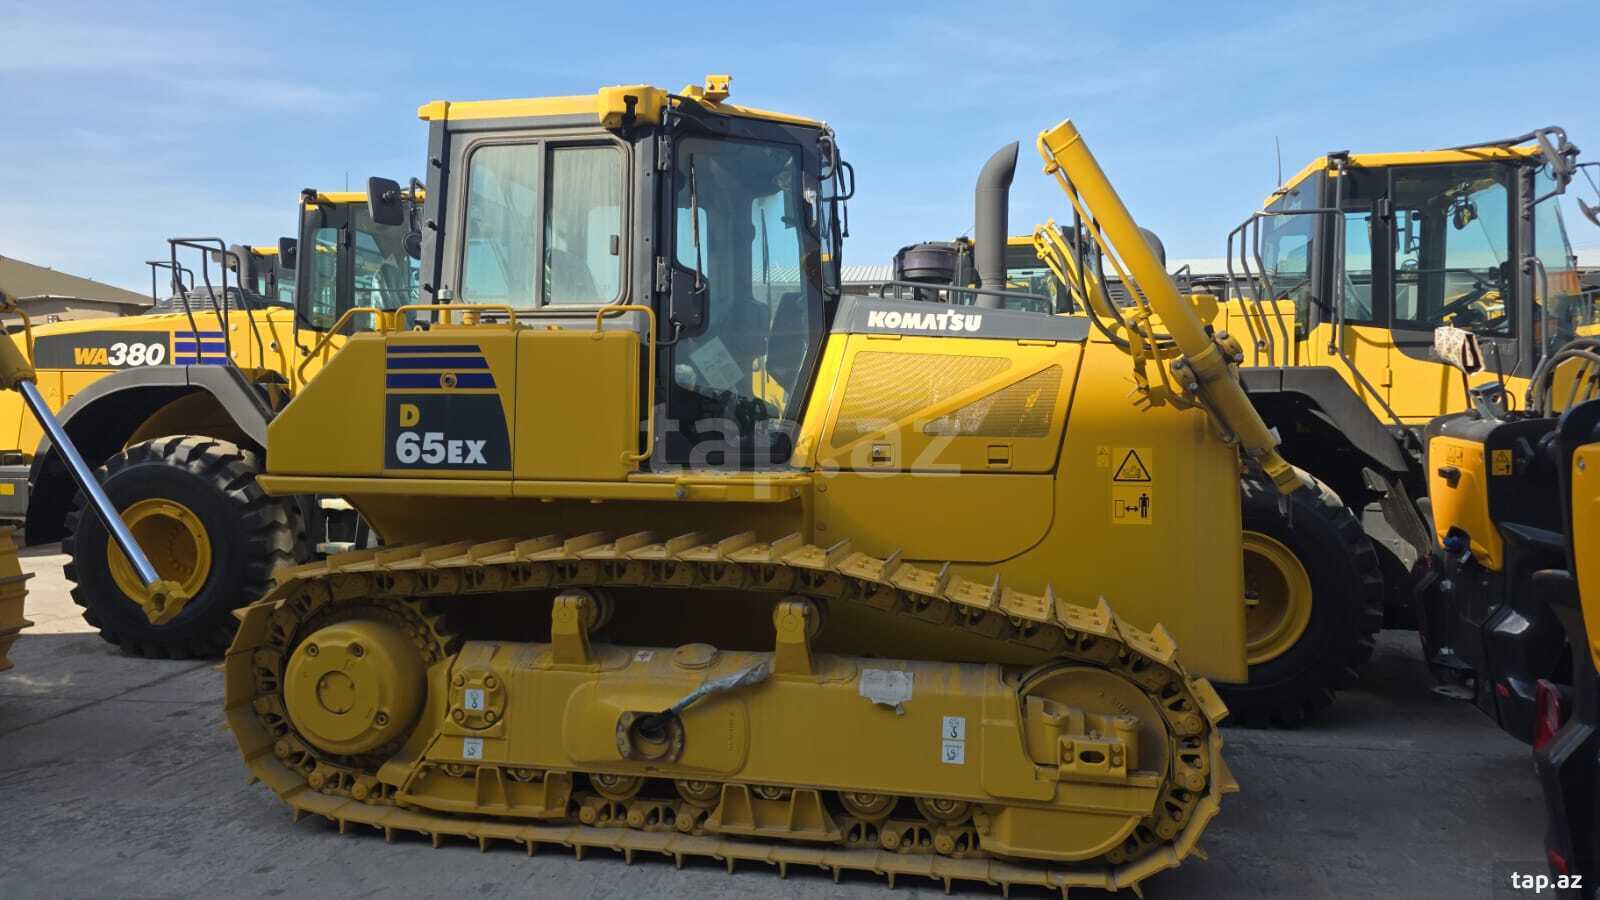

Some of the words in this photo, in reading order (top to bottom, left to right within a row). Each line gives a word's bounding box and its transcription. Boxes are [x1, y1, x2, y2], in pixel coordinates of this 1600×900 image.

[867, 309, 983, 332] KOMATSU
[74, 342, 166, 367] WA380
[399, 403, 420, 428] D
[396, 431, 488, 464] 65EX
